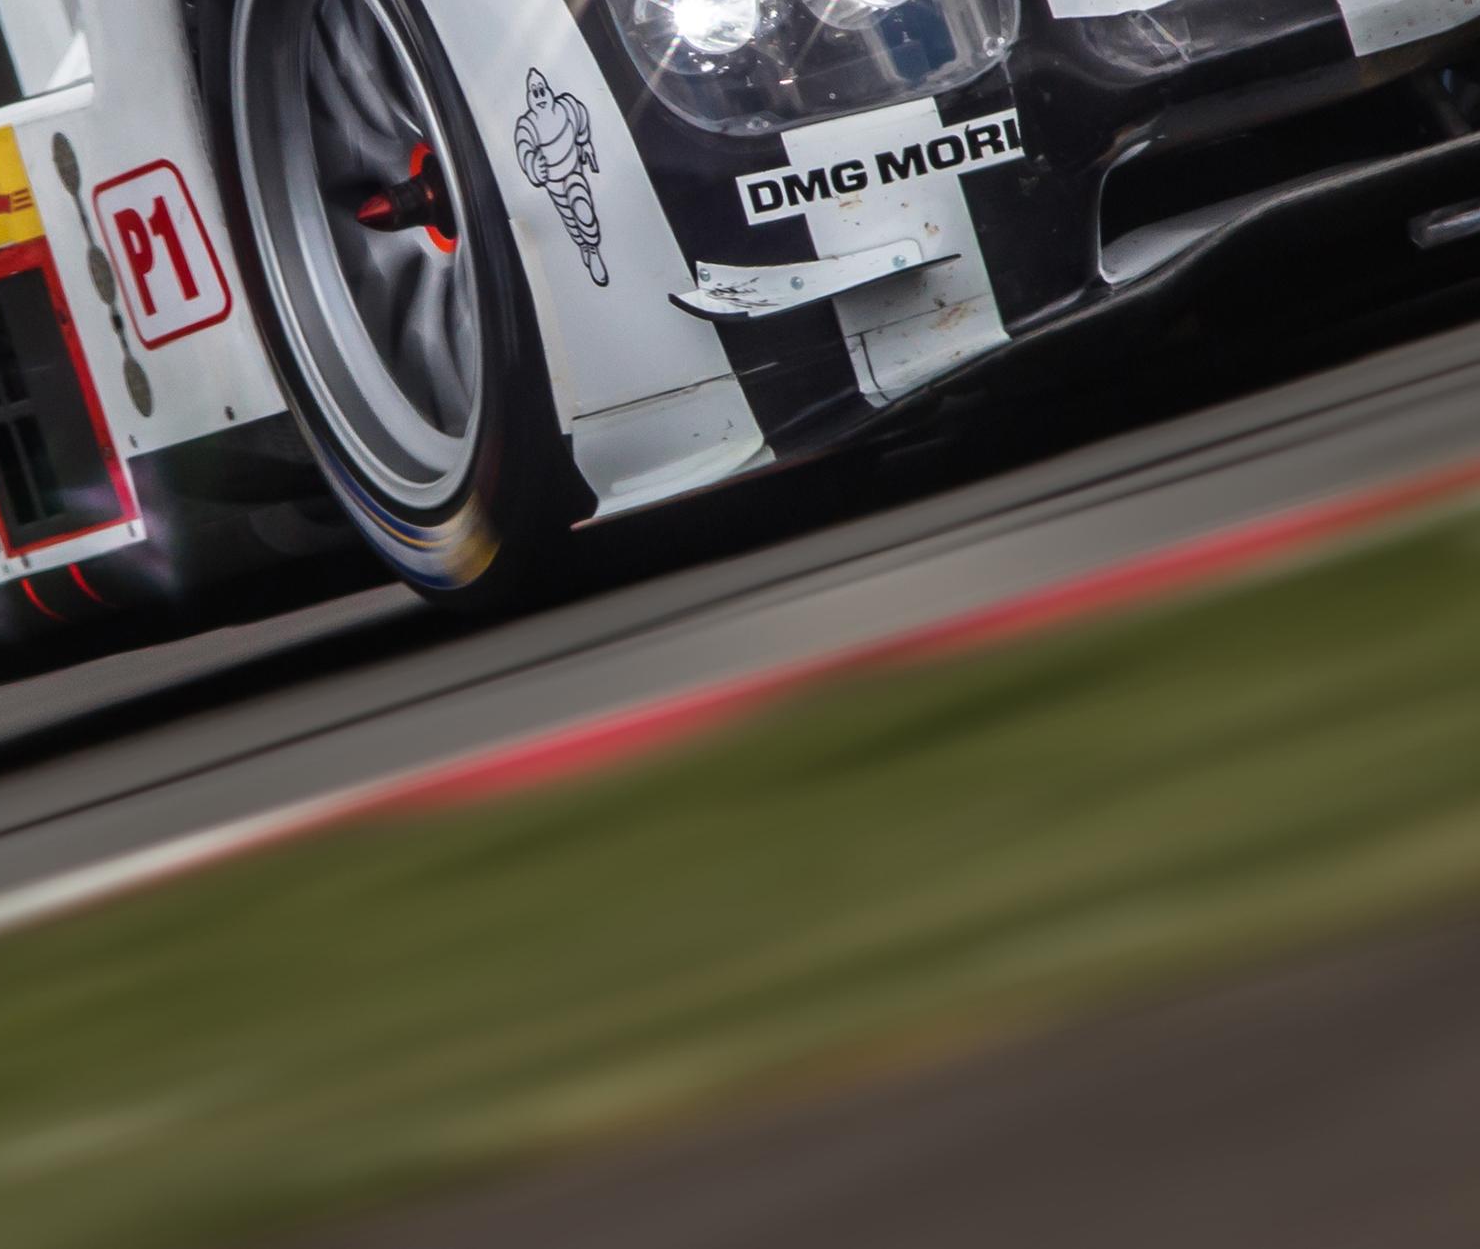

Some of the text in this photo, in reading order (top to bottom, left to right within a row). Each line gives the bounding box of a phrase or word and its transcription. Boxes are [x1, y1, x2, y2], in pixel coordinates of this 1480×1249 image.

[747, 118, 1020, 214] DMG MORI
[114, 195, 199, 317] P1
